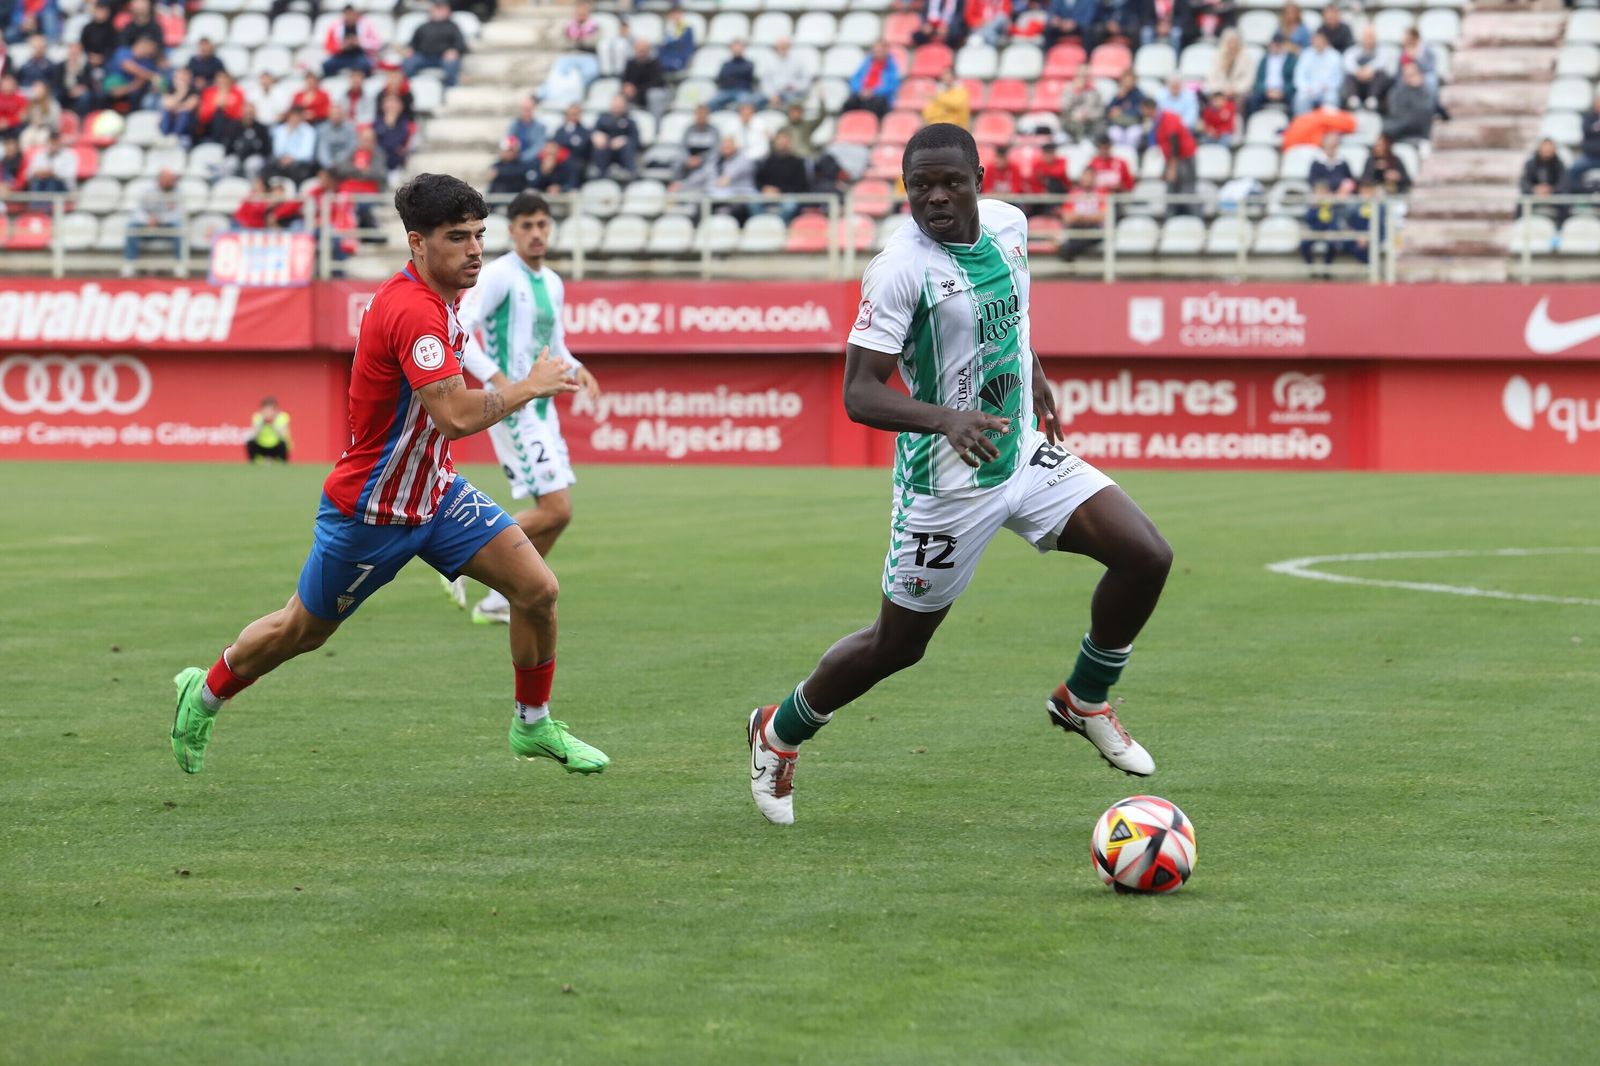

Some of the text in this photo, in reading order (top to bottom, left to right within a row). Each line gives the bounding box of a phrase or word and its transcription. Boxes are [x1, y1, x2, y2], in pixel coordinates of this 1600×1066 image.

[680, 300, 833, 333] PODOLOGÍA
[1180, 290, 1307, 326] FÚTBOL
[1179, 325, 1306, 348] COALITION
[571, 384, 803, 422] Ayuntamiento
[27, 421, 117, 449] Campo
[121, 422, 152, 447] de
[590, 418, 783, 459] de Algeciras
[1145, 427, 1333, 461] ALGECIREÑO
[530, 440, 550, 464] 2
[912, 532, 958, 570] 12
[346, 563, 375, 593] 7
